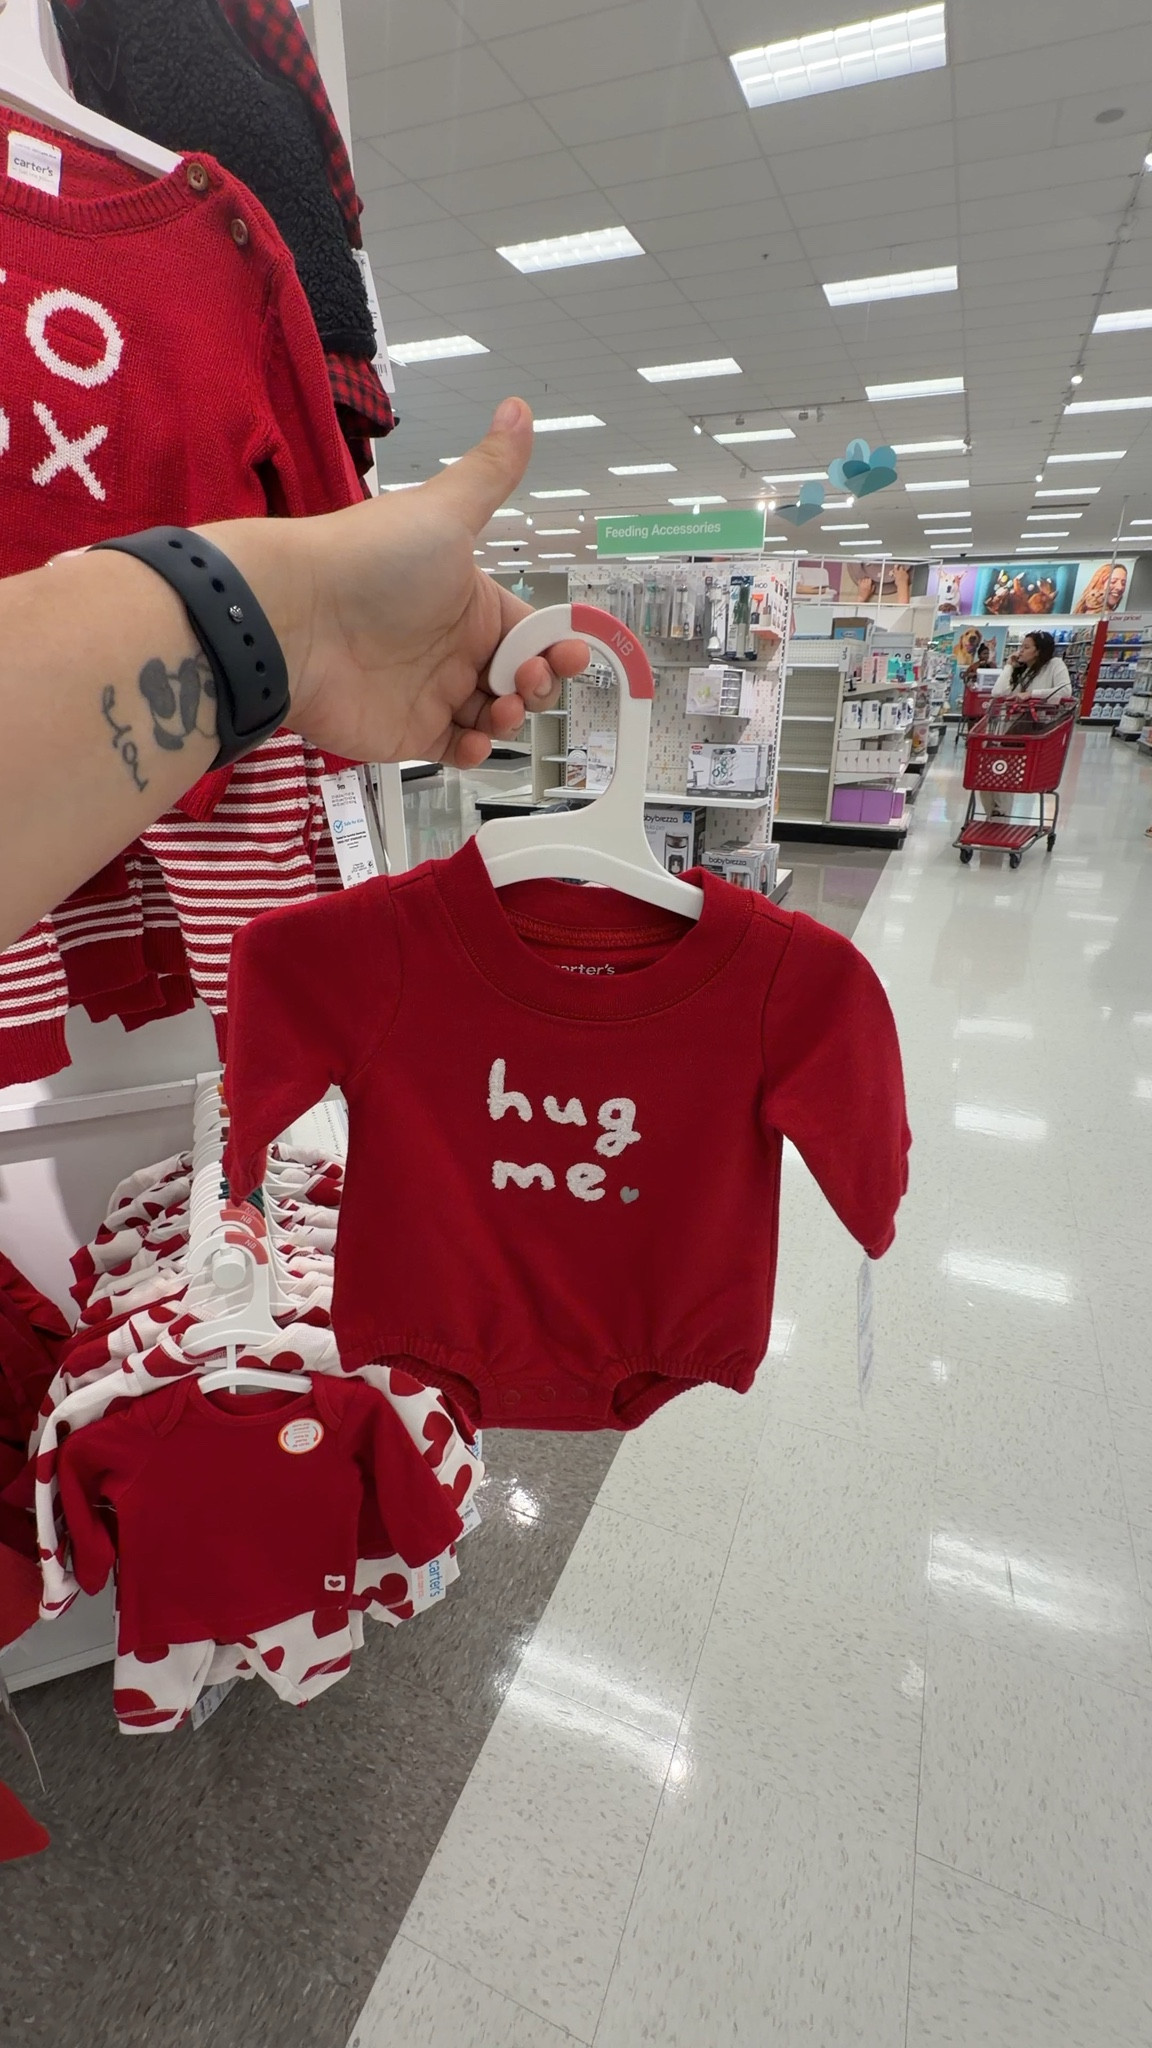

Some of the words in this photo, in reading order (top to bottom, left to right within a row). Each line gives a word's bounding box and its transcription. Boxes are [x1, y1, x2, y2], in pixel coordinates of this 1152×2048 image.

[13, 157, 53, 177] carter's
[605, 525, 648, 539] Feeding
[651, 521, 721, 536] Accessories
[611, 630, 634, 656] NB
[486, 1058, 642, 1158] hug
[240, 1214, 253, 1224] NB
[245, 1239, 257, 1249] NB
[428, 1559, 442, 1597] carter's
